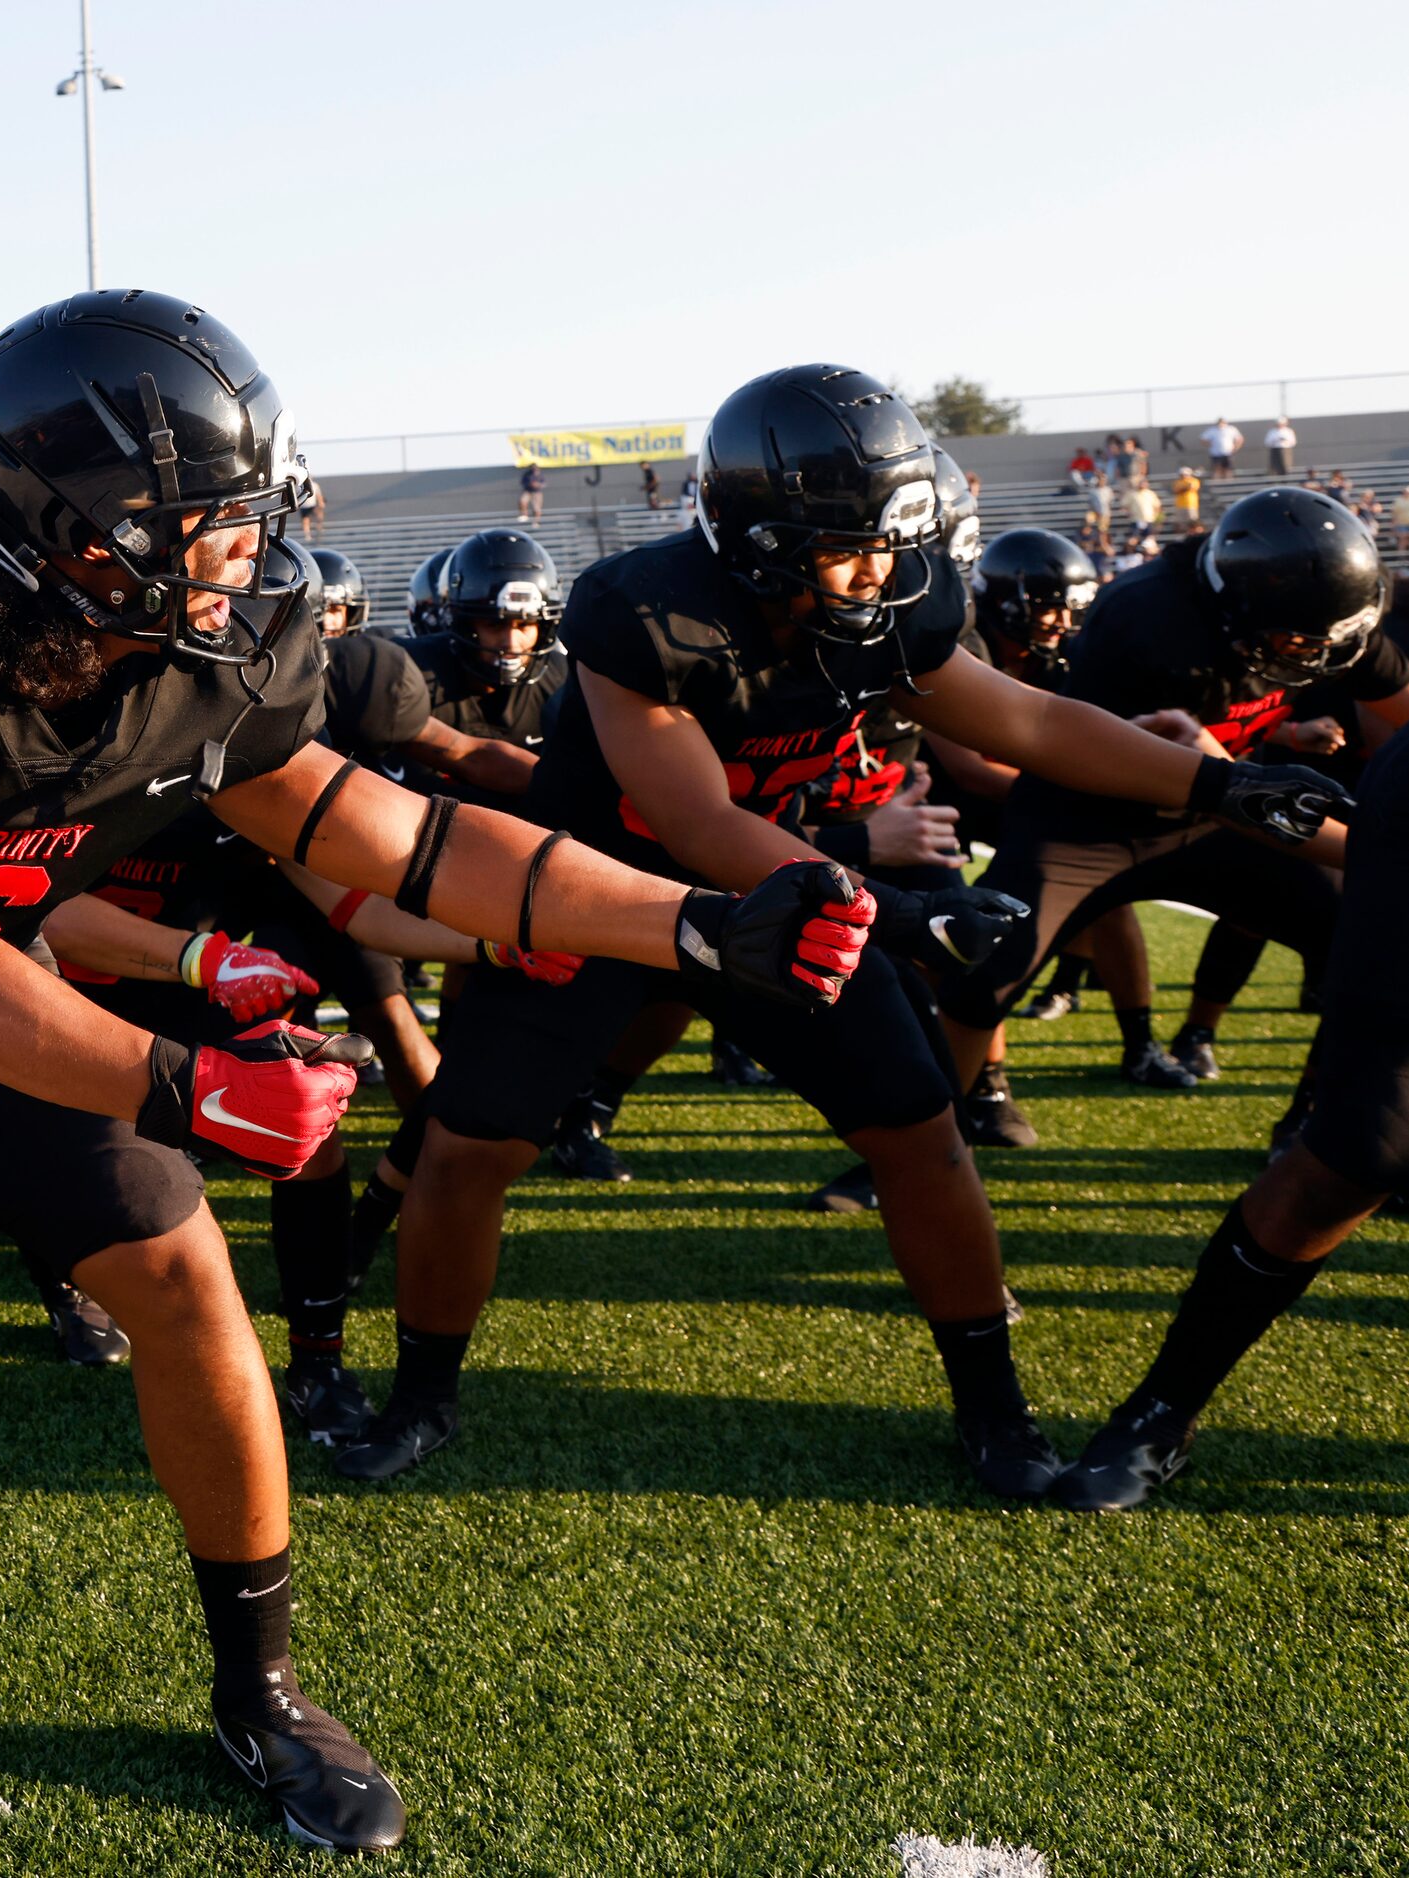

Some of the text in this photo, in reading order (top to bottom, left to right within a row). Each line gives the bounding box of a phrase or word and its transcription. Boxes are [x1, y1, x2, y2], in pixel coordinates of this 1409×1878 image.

[514, 432, 683, 461] Viking Nation
[1161, 427, 1184, 451] K
[584, 466, 601, 487] J
[737, 729, 824, 757] TRINITY
[108, 857, 190, 885] RINITY
